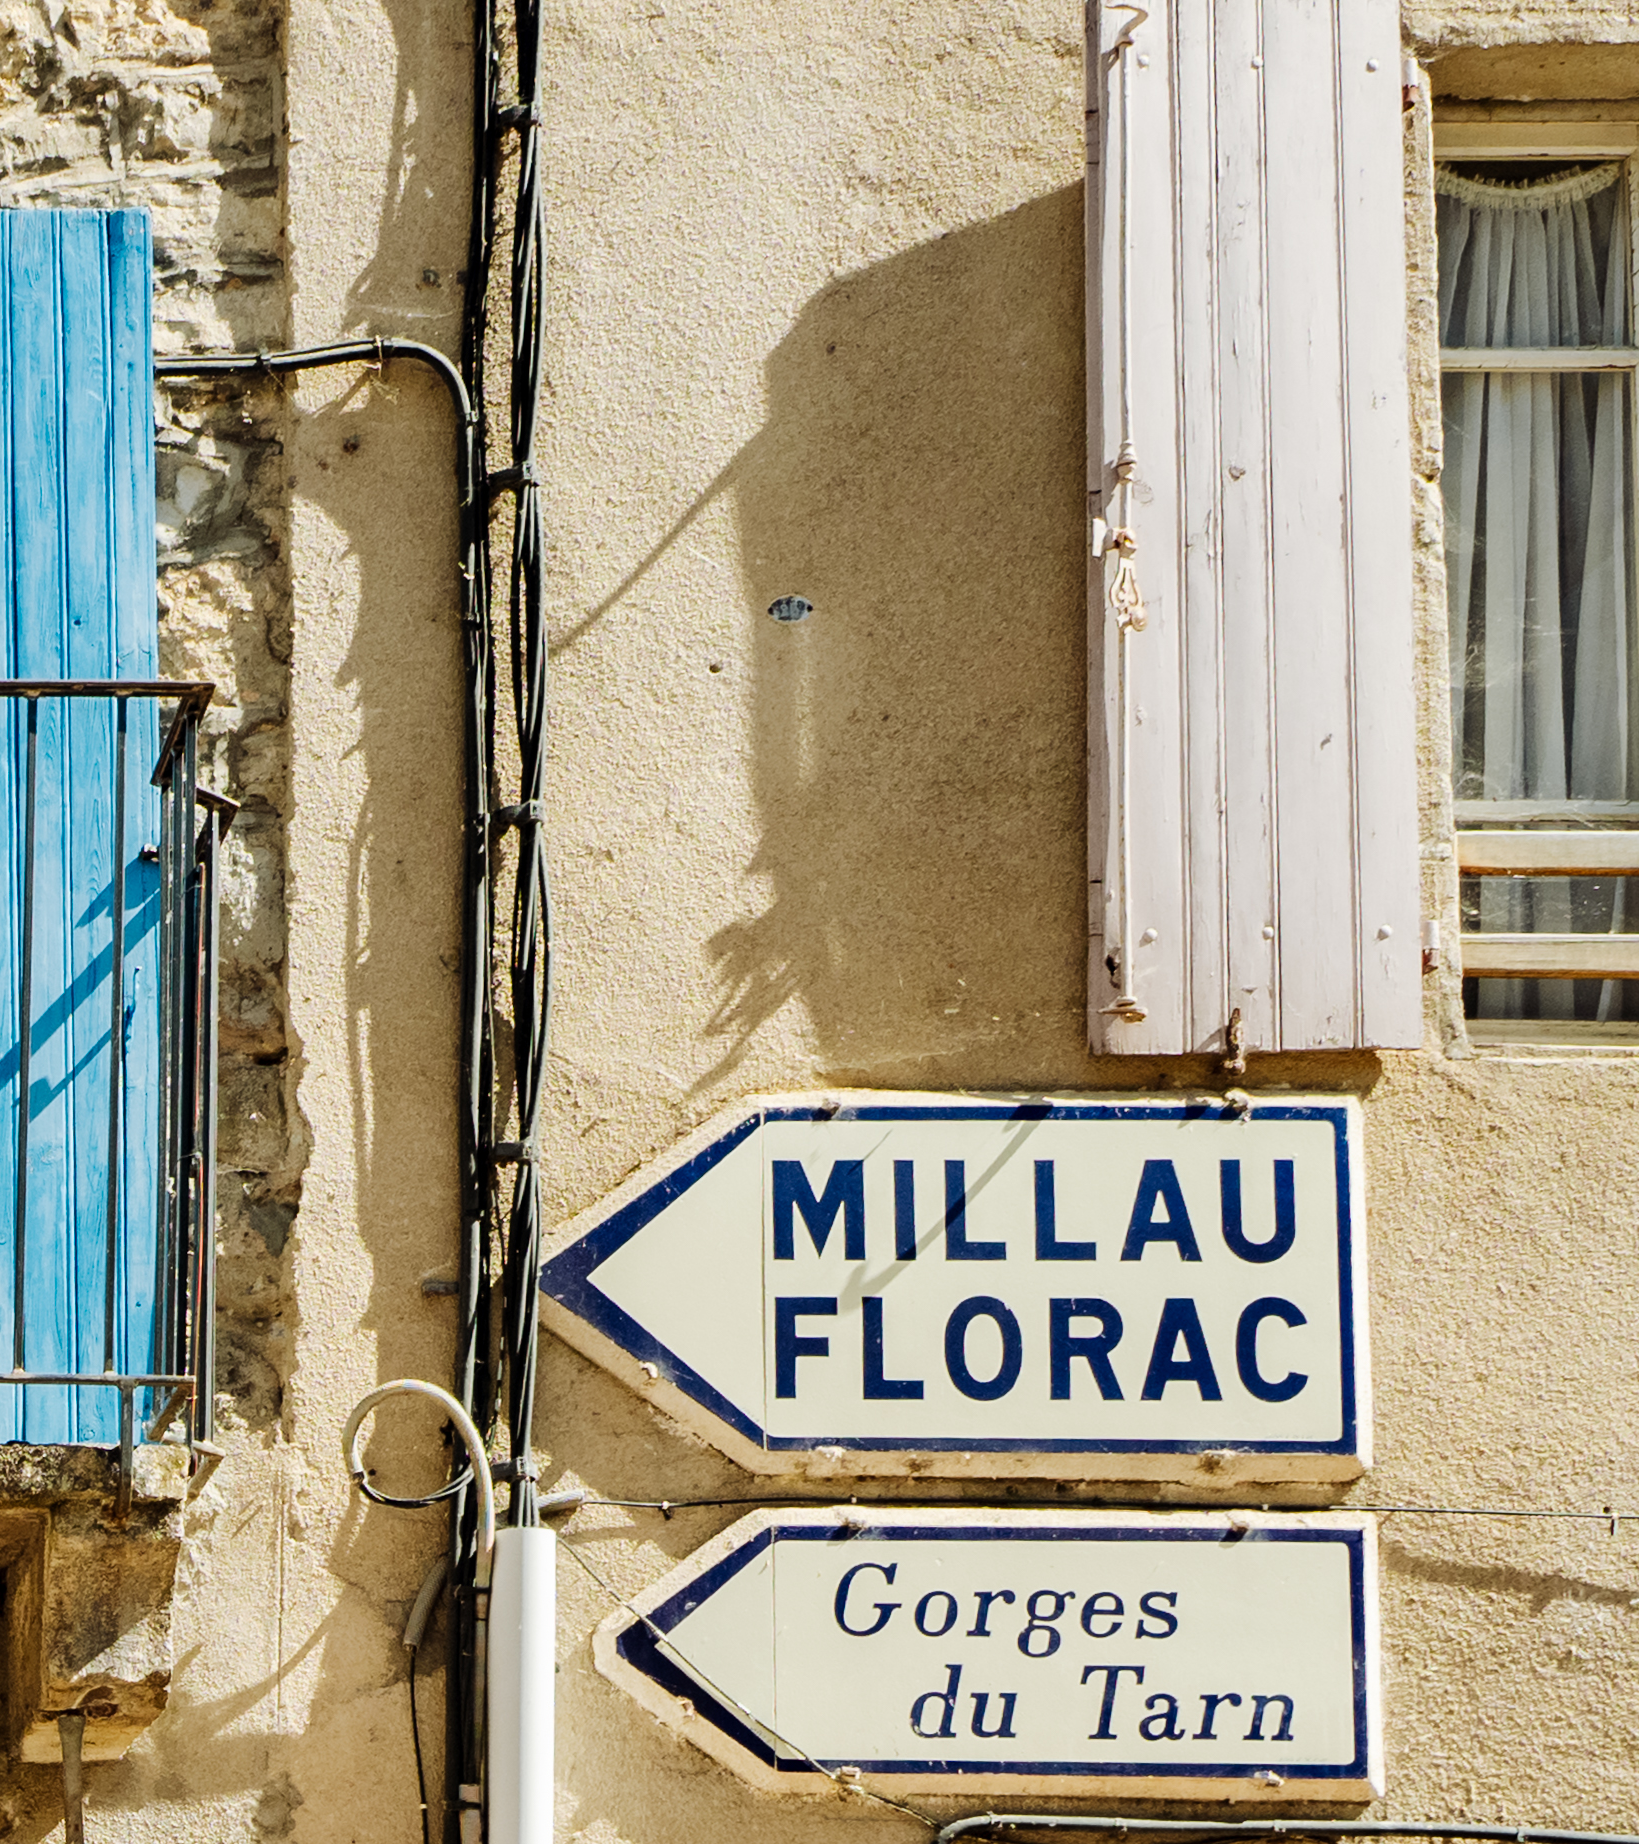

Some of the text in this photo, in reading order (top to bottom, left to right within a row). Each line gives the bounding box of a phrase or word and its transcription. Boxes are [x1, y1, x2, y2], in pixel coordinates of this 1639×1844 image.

[771, 1159, 1296, 1263] MILLAU
[774, 1295, 1309, 1402] FLORAC
[833, 1561, 1179, 1658] Gorges
[910, 1663, 1295, 1742] du Tarn
